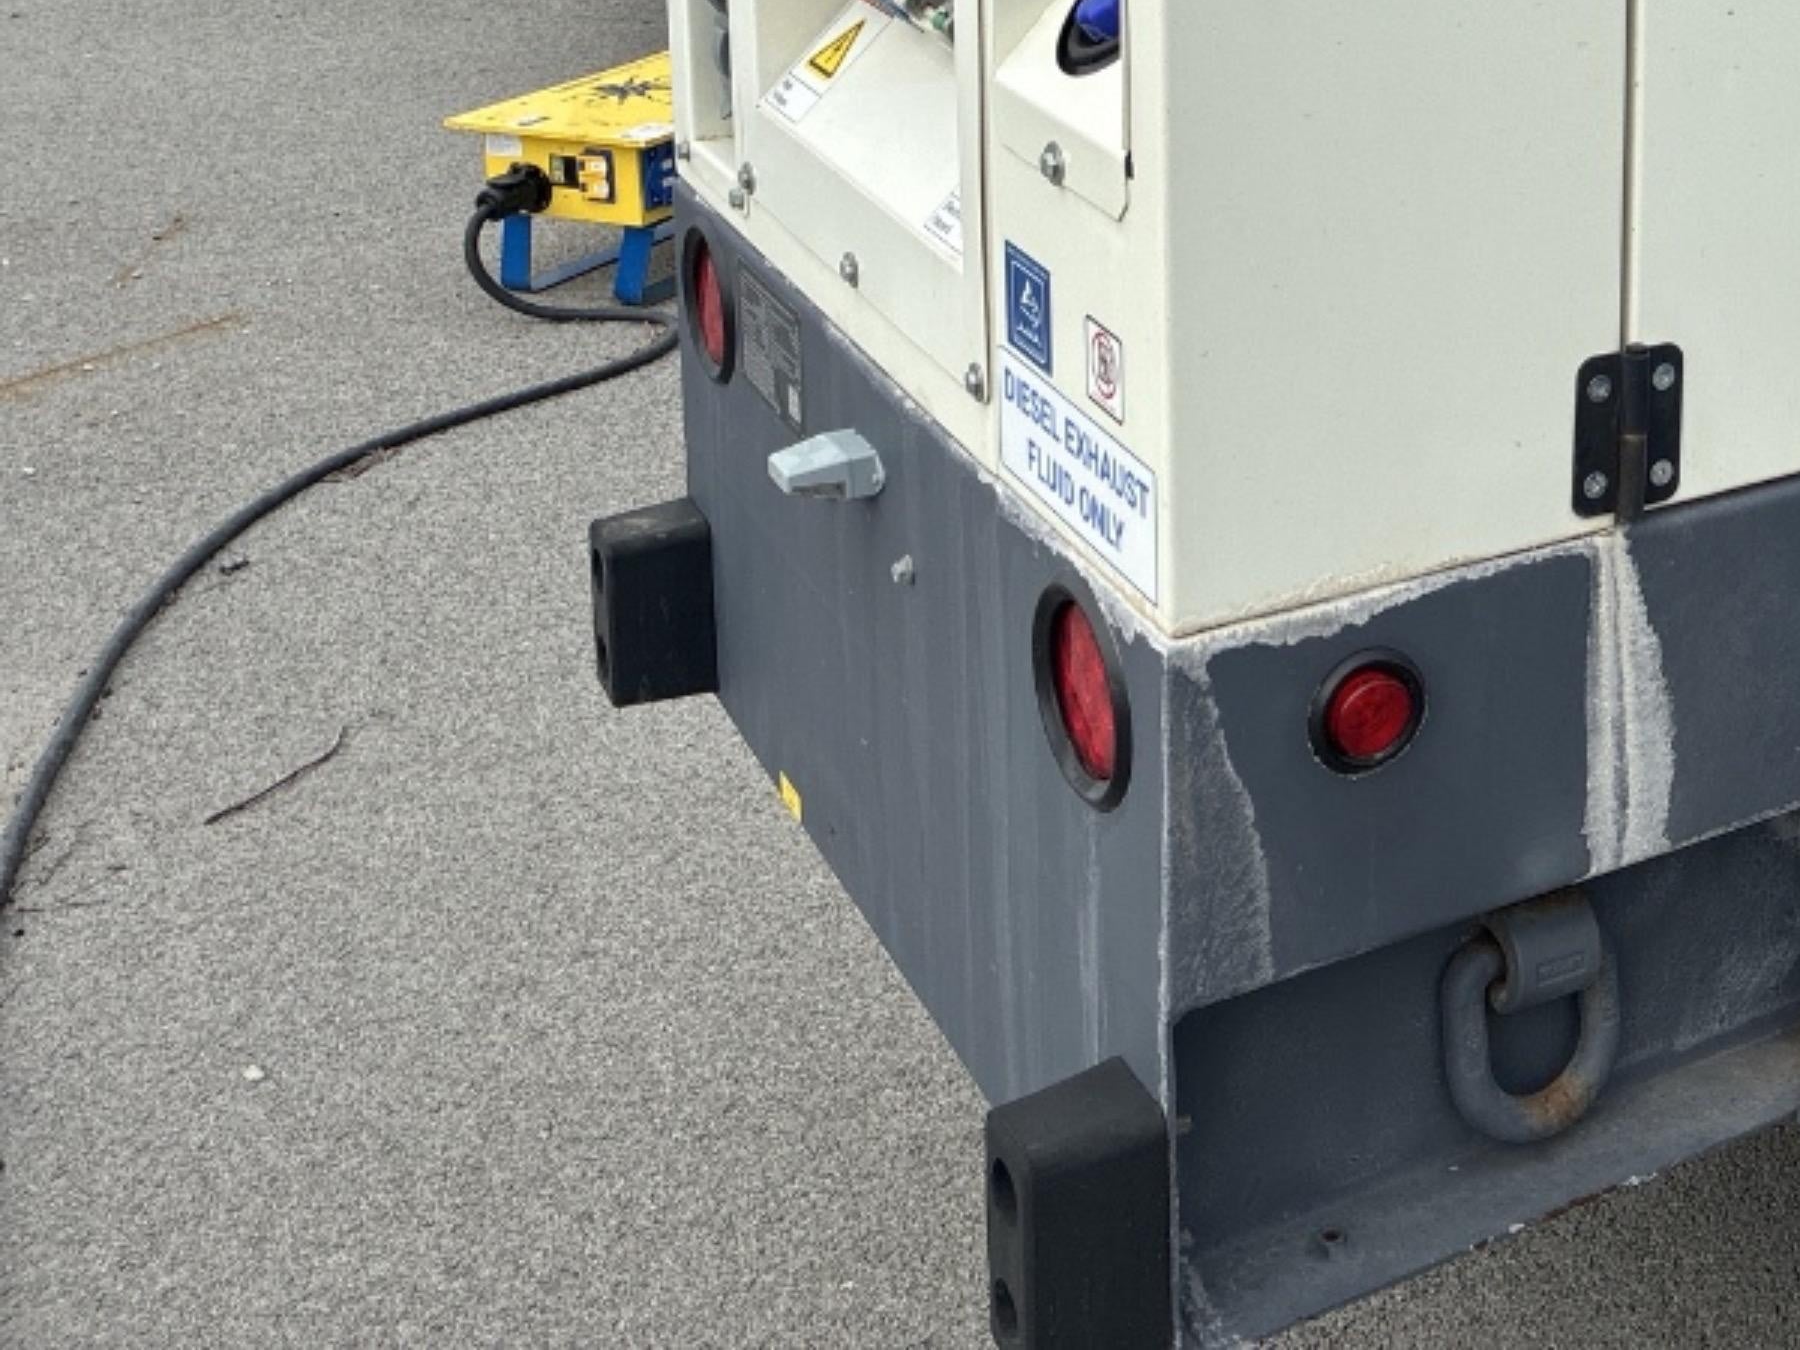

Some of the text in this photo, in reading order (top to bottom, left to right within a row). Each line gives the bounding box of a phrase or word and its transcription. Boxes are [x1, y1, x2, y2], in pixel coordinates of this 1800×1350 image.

[1004, 365, 1150, 519] DIESEL EXHAUST
[1027, 437, 1125, 553] FLUID ONLY
